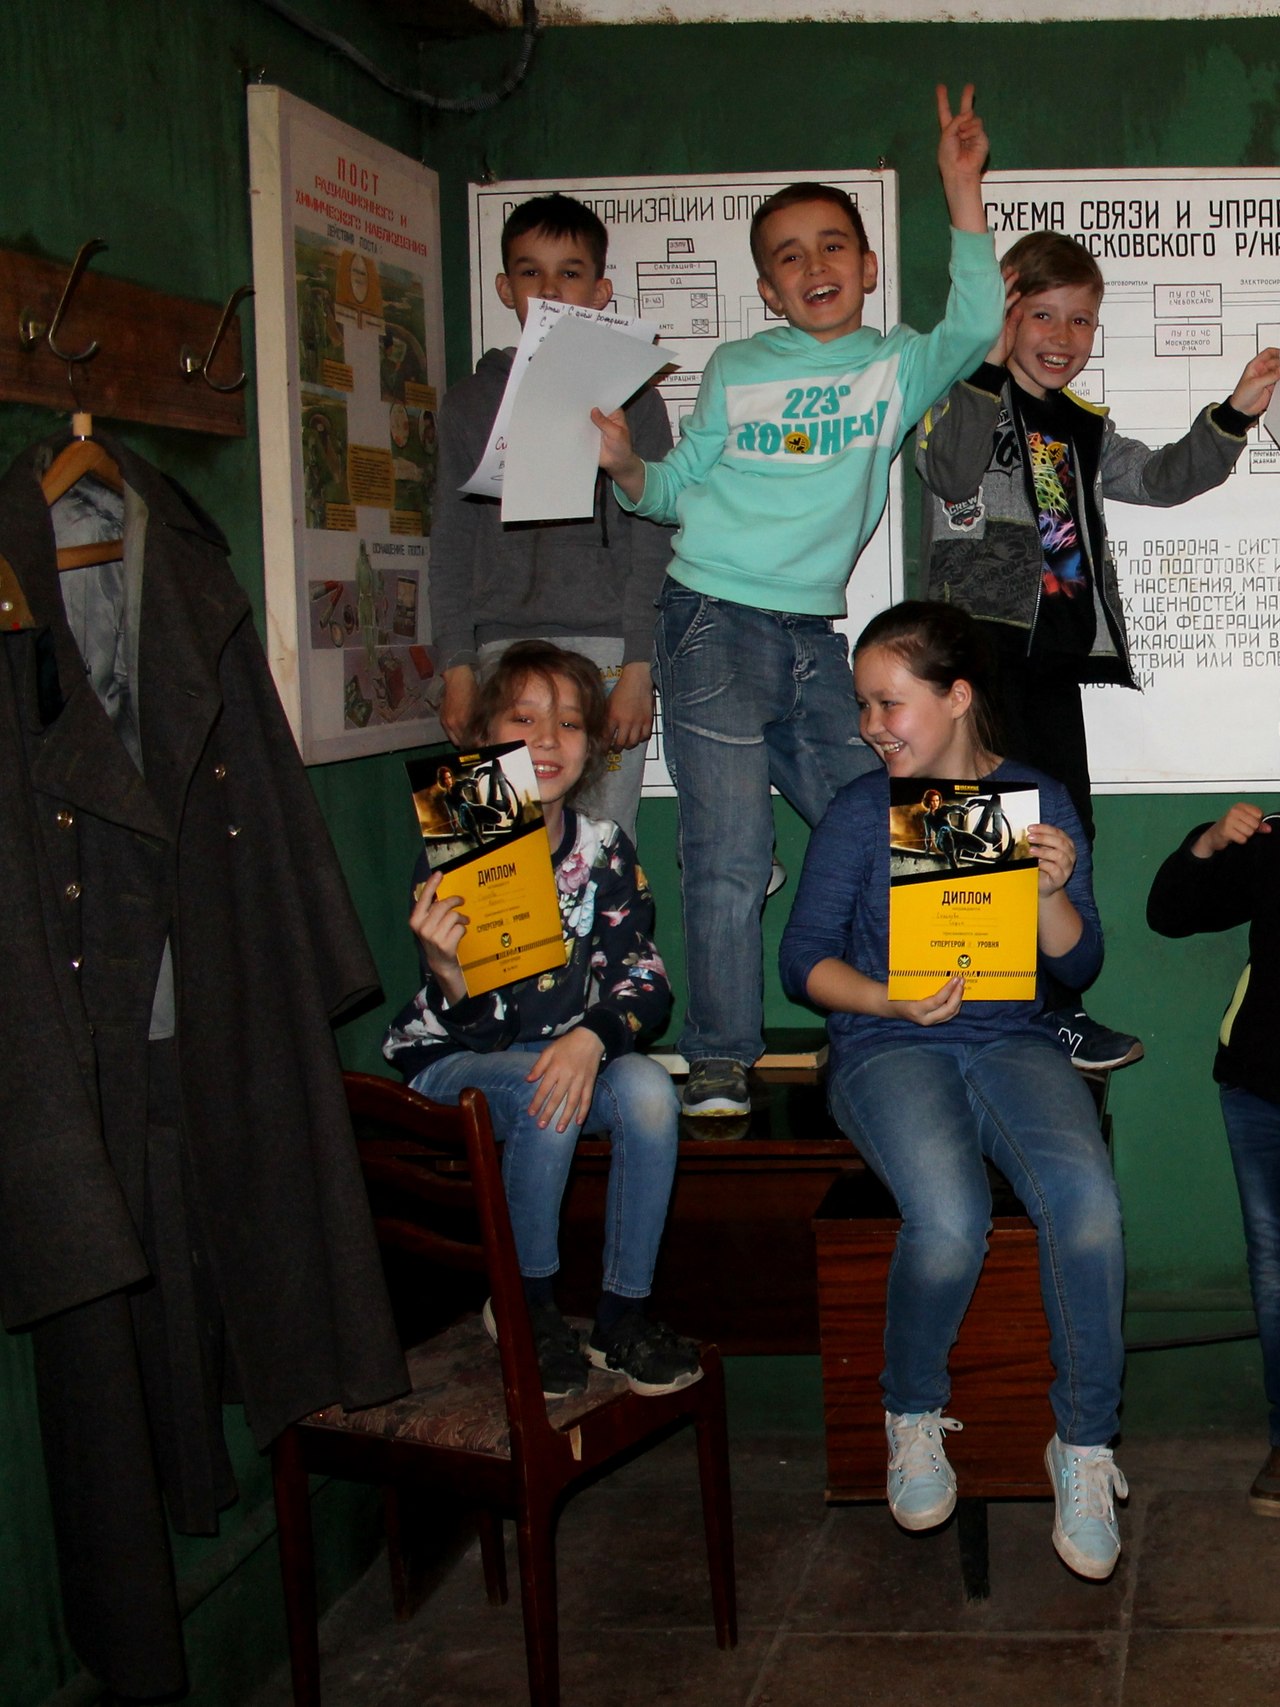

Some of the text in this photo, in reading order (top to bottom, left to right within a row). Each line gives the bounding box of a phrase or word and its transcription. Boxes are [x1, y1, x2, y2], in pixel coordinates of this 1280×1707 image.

[338, 157, 379, 196] ПОСТ
[984, 202, 1065, 232] СХЕМА
[1080, 200, 1159, 230] СВЯЗИ
[1177, 199, 1191, 229] И
[1070, 232, 1216, 258] ОСКОВСКОГО
[1169, 289, 1212, 298] ПУ ГО ЧС
[1200, 329, 1212, 337] ЧС
[950, 495, 978, 515] CREW
[1143, 539, 1219, 557] ОБОРОНА
[1129, 559, 1152, 575] ПО
[1160, 557, 1267, 575] ПОДГОТОВКЕ
[1134, 577, 1237, 597] НАСЕЛЕНИЯ,
[1143, 592, 1246, 613] ЦЕННОСТЕЙ
[1256, 595, 1279, 611] НА
[1225, 632, 1260, 649] ПРИ
[1196, 652, 1233, 668] ИЛИ
[477, 861, 517, 888] ДИПЛОМ
[942, 890, 991, 906] ДИПЛОМ
[930, 939, 1000, 949] СУПЕРГЕРОЙ УРОВНЯ
